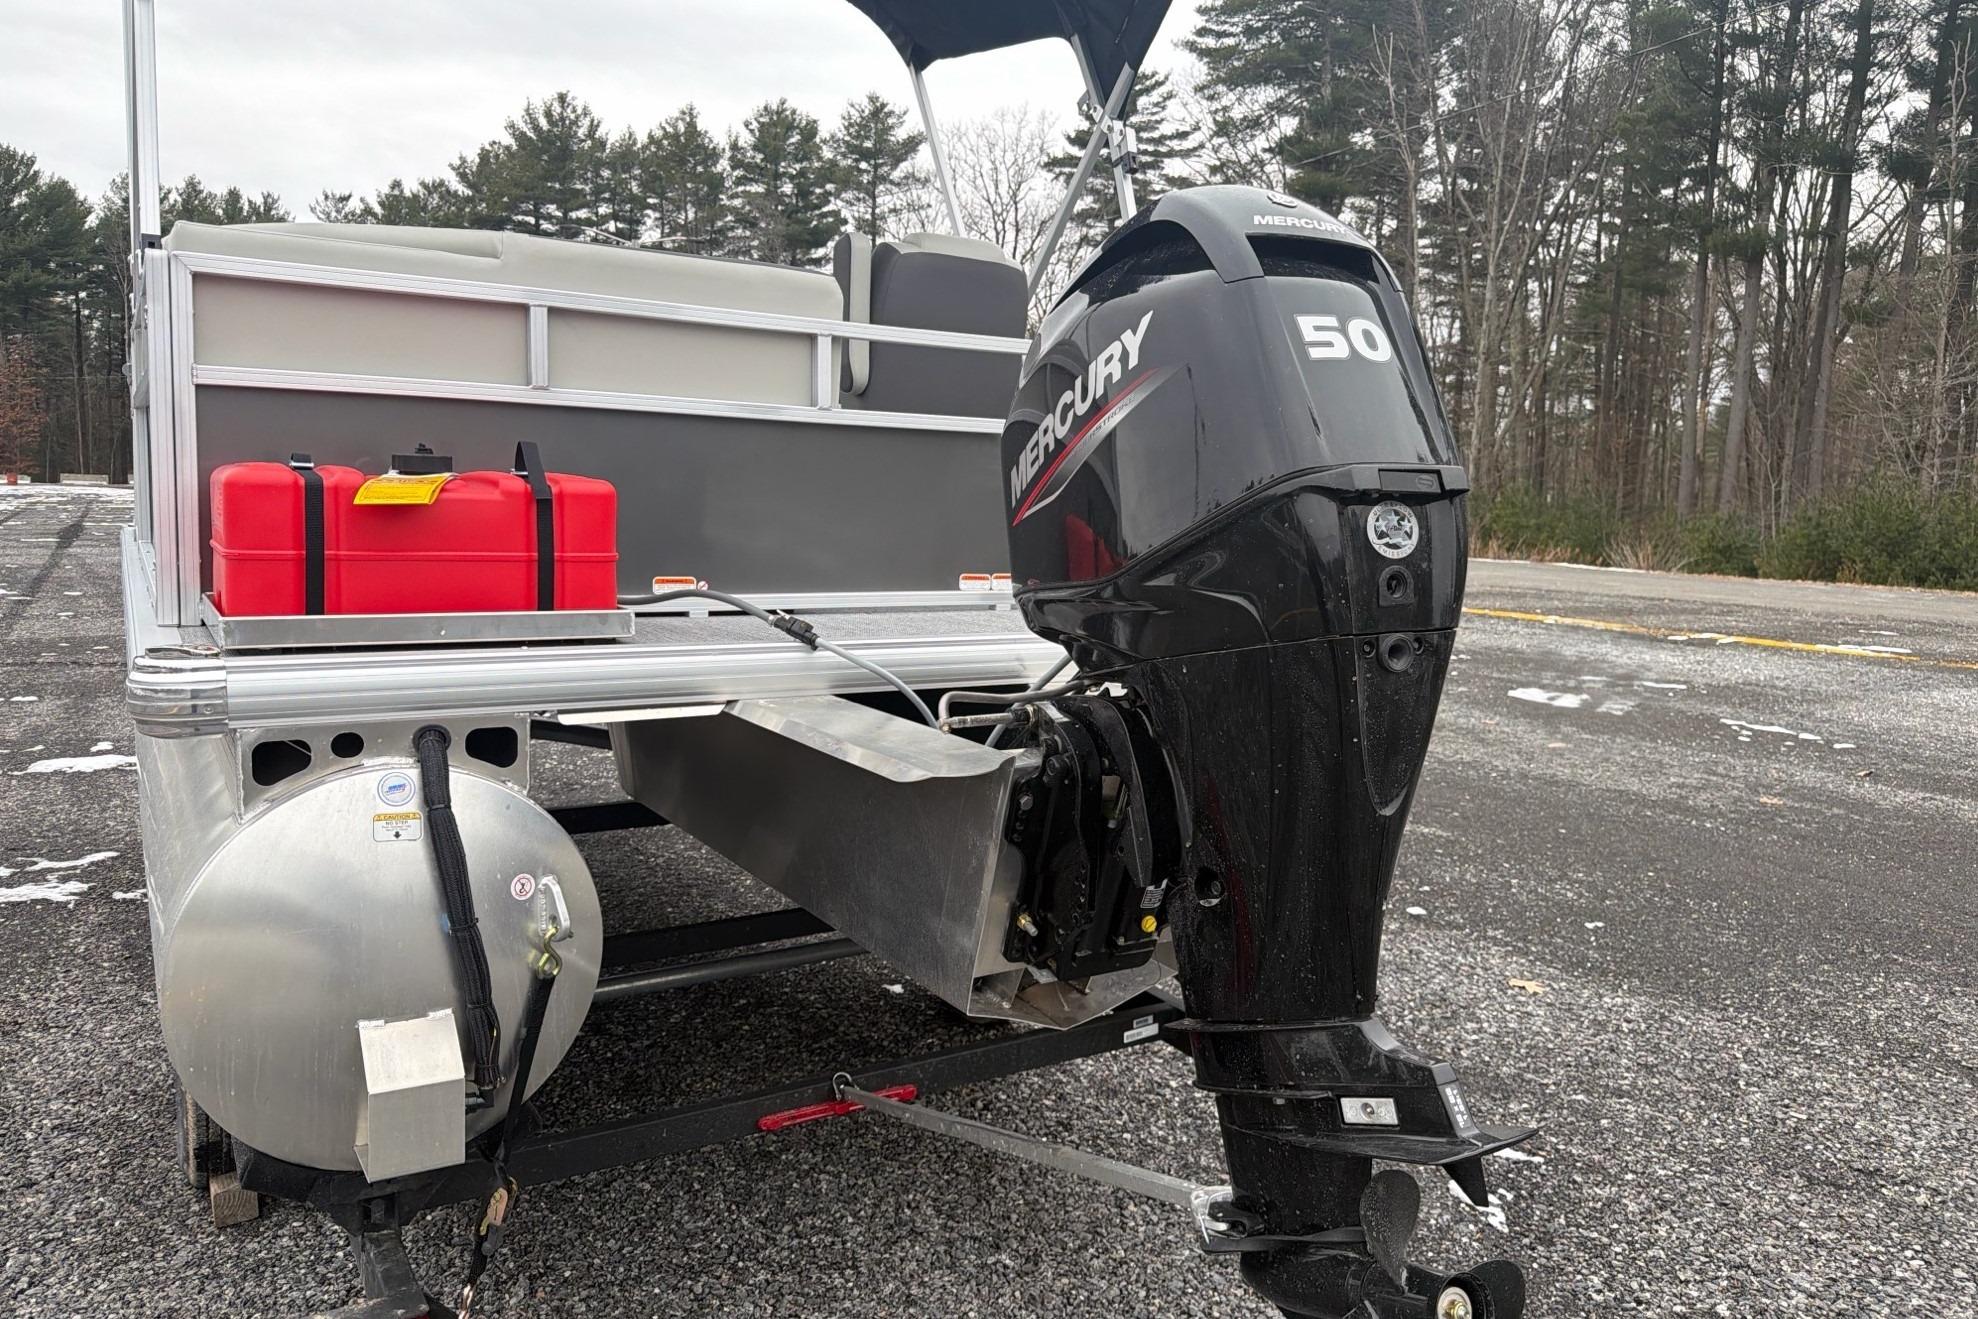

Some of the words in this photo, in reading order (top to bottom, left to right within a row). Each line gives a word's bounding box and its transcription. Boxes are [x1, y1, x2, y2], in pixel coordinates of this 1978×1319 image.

[1253, 214, 1347, 234] MERCURY
[1294, 315, 1392, 362] 50
[1010, 310, 1153, 508] MERCURY
